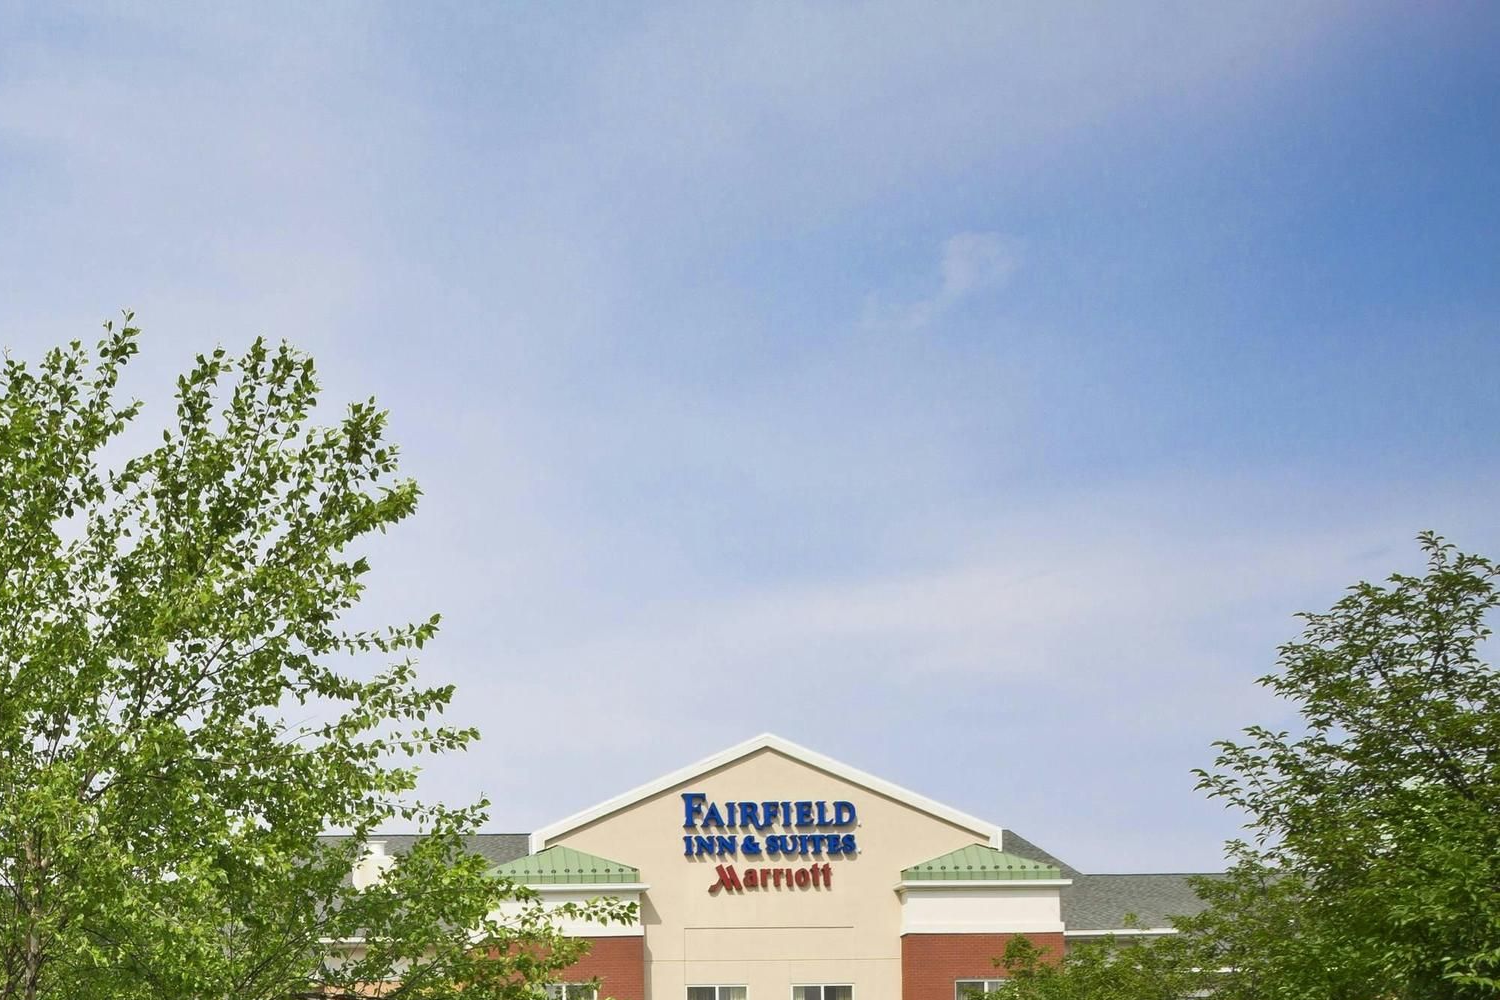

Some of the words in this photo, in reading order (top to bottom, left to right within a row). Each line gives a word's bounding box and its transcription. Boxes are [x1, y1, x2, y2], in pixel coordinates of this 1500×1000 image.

[681, 792, 856, 830] FAIRFIELD
[683, 835, 737, 856] INN
[740, 835, 762, 855] &
[765, 834, 856, 855] SUITES
[708, 862, 832, 893] Marriott
